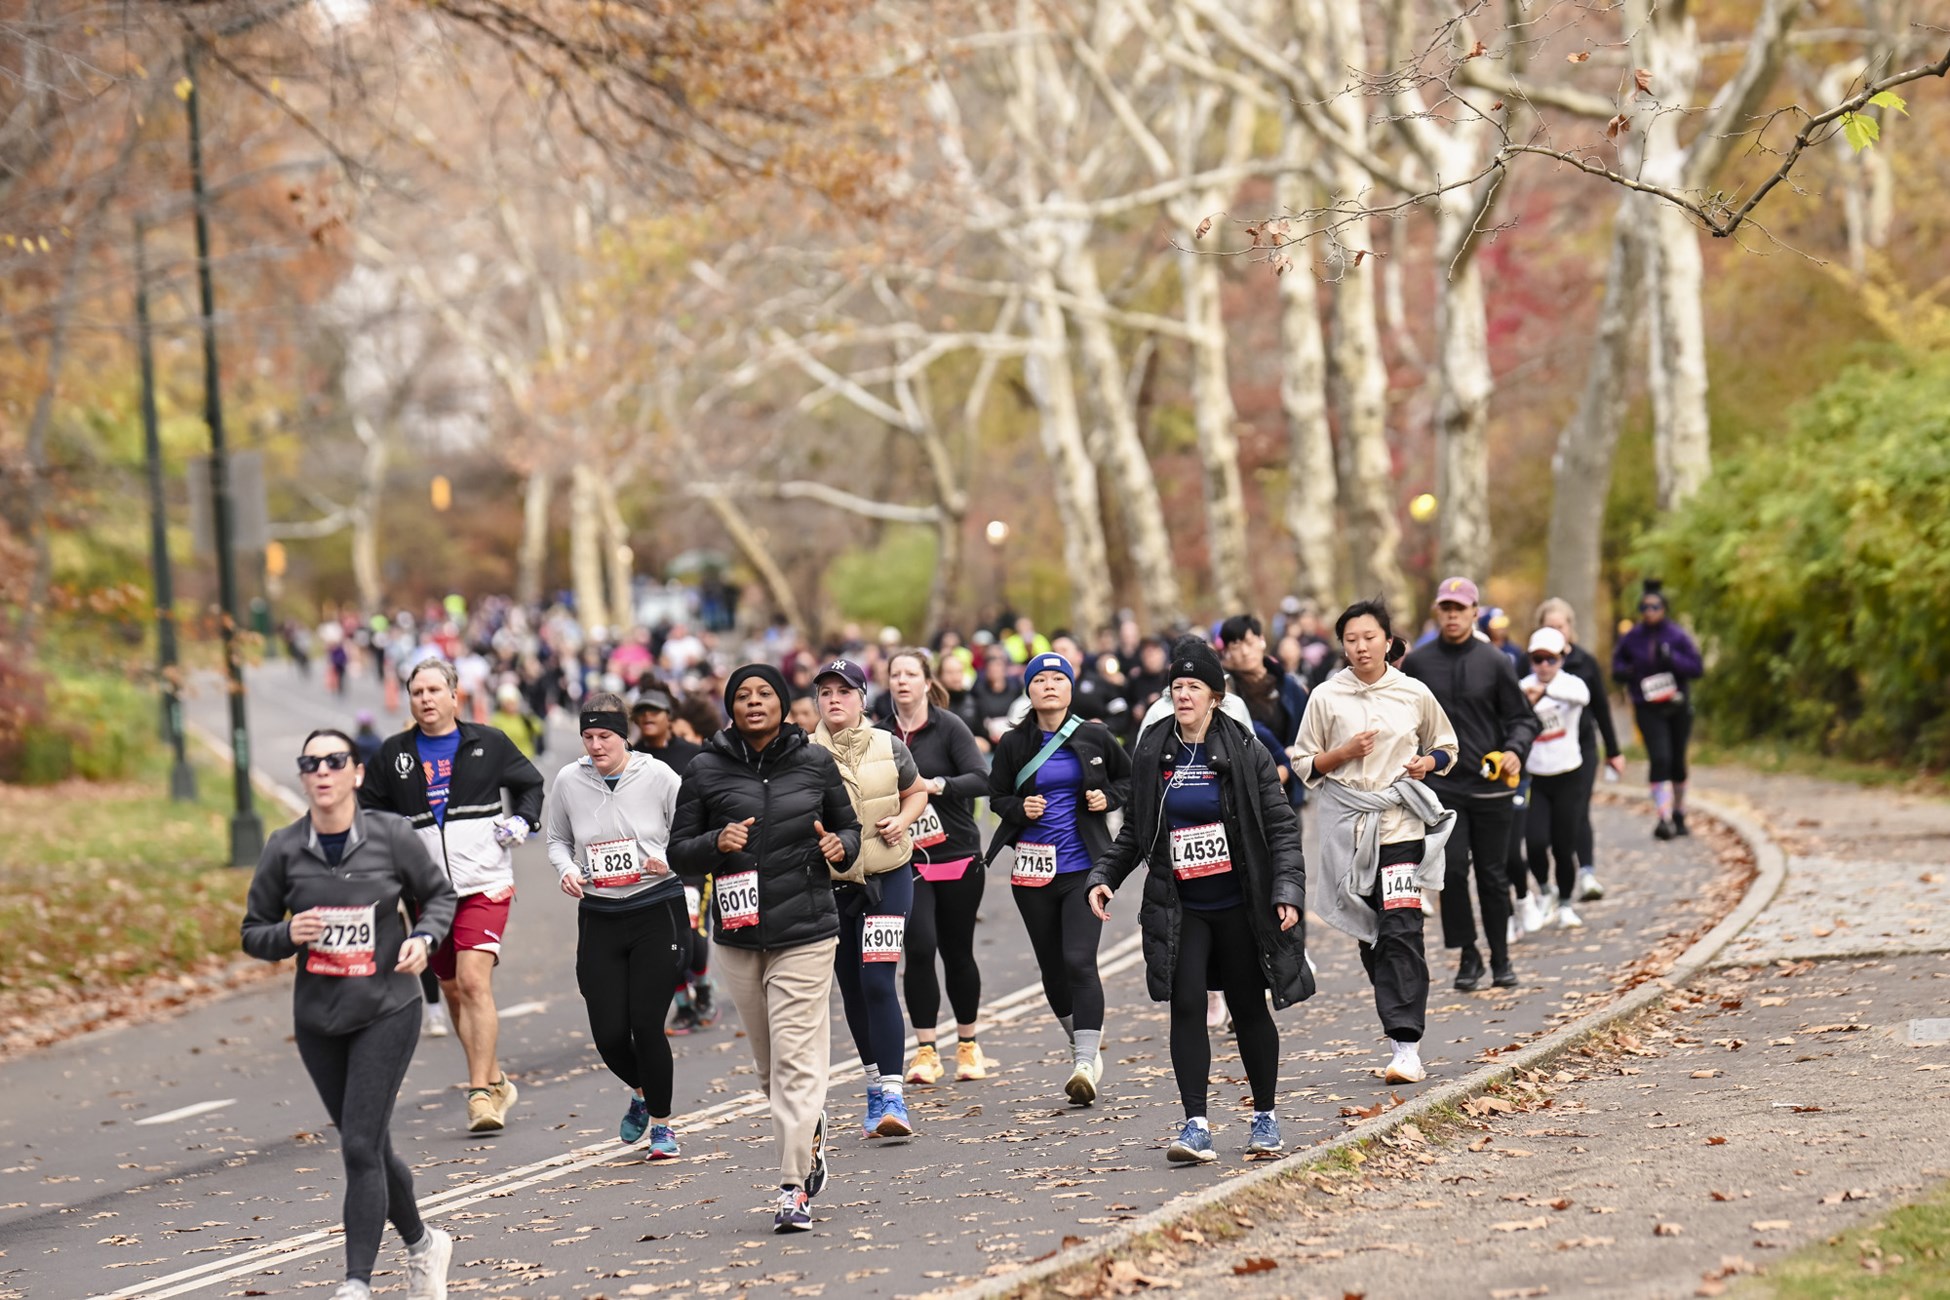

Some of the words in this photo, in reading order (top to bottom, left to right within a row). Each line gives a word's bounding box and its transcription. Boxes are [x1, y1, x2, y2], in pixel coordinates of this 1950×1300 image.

[604, 852, 633, 872] 828
[719, 887, 758, 912] 6016
[323, 924, 370, 946] 2729
